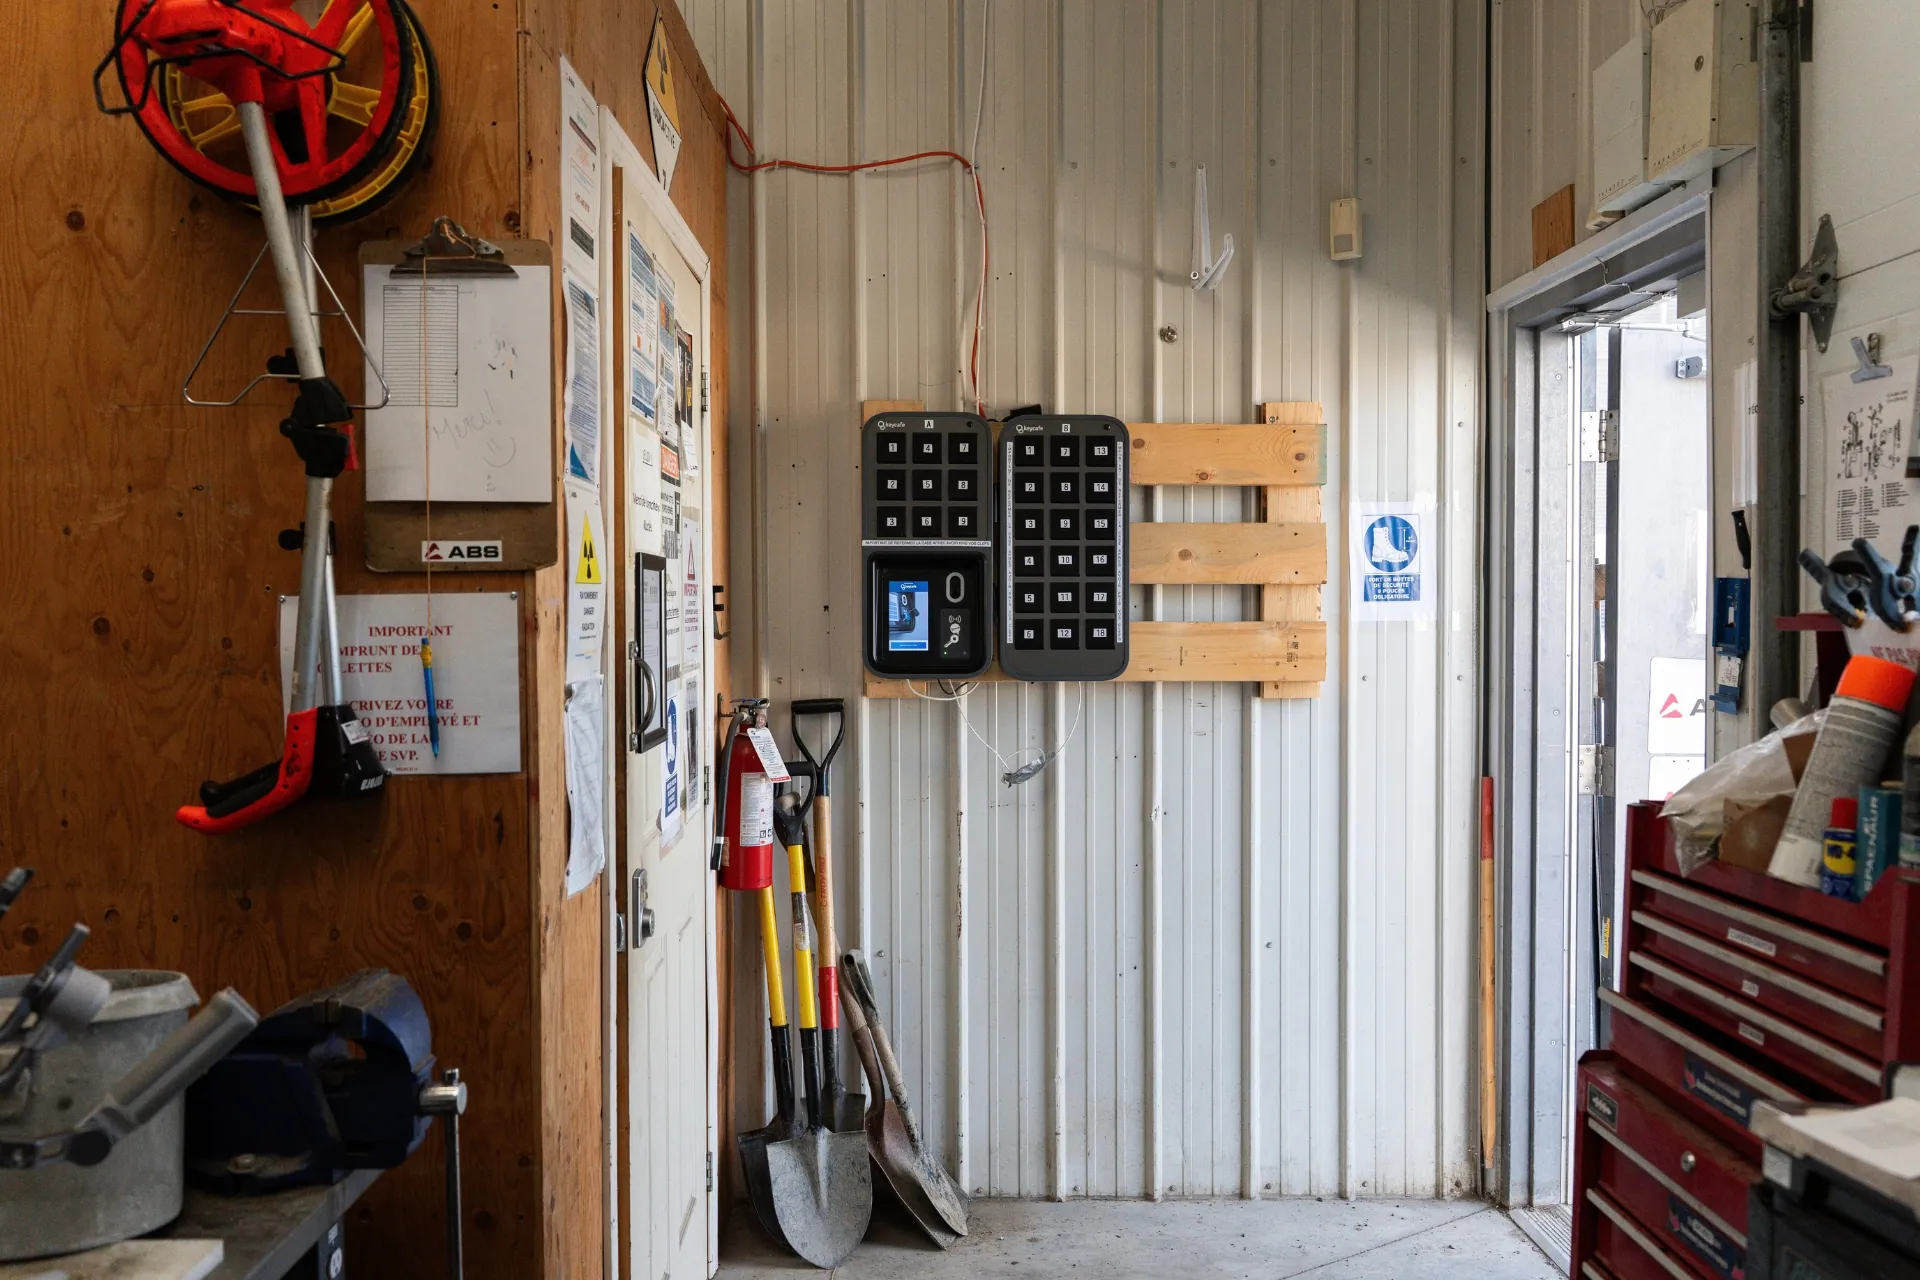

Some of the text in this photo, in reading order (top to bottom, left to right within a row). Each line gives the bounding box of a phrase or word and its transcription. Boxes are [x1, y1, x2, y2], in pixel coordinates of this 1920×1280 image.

[1096, 447, 1106, 455] 13
[1096, 520, 1106, 528] 15
[448, 545, 500, 558] ABS
[1095, 555, 1105, 564] 16
[368, 626, 453, 636] IMPORTANT
[1060, 629, 1070, 637] 12
[1096, 629, 1105, 637] 18
[339, 645, 420, 656] MPRUNT DE
[347, 699, 454, 711] CRIVEZ VORE
[376, 713, 481, 728] D'EMPLYÉ ET
[388, 733, 430, 744] DE LA
[390, 750, 419, 761] SVP.
[1864, 796, 1880, 891] SPAENAUR
